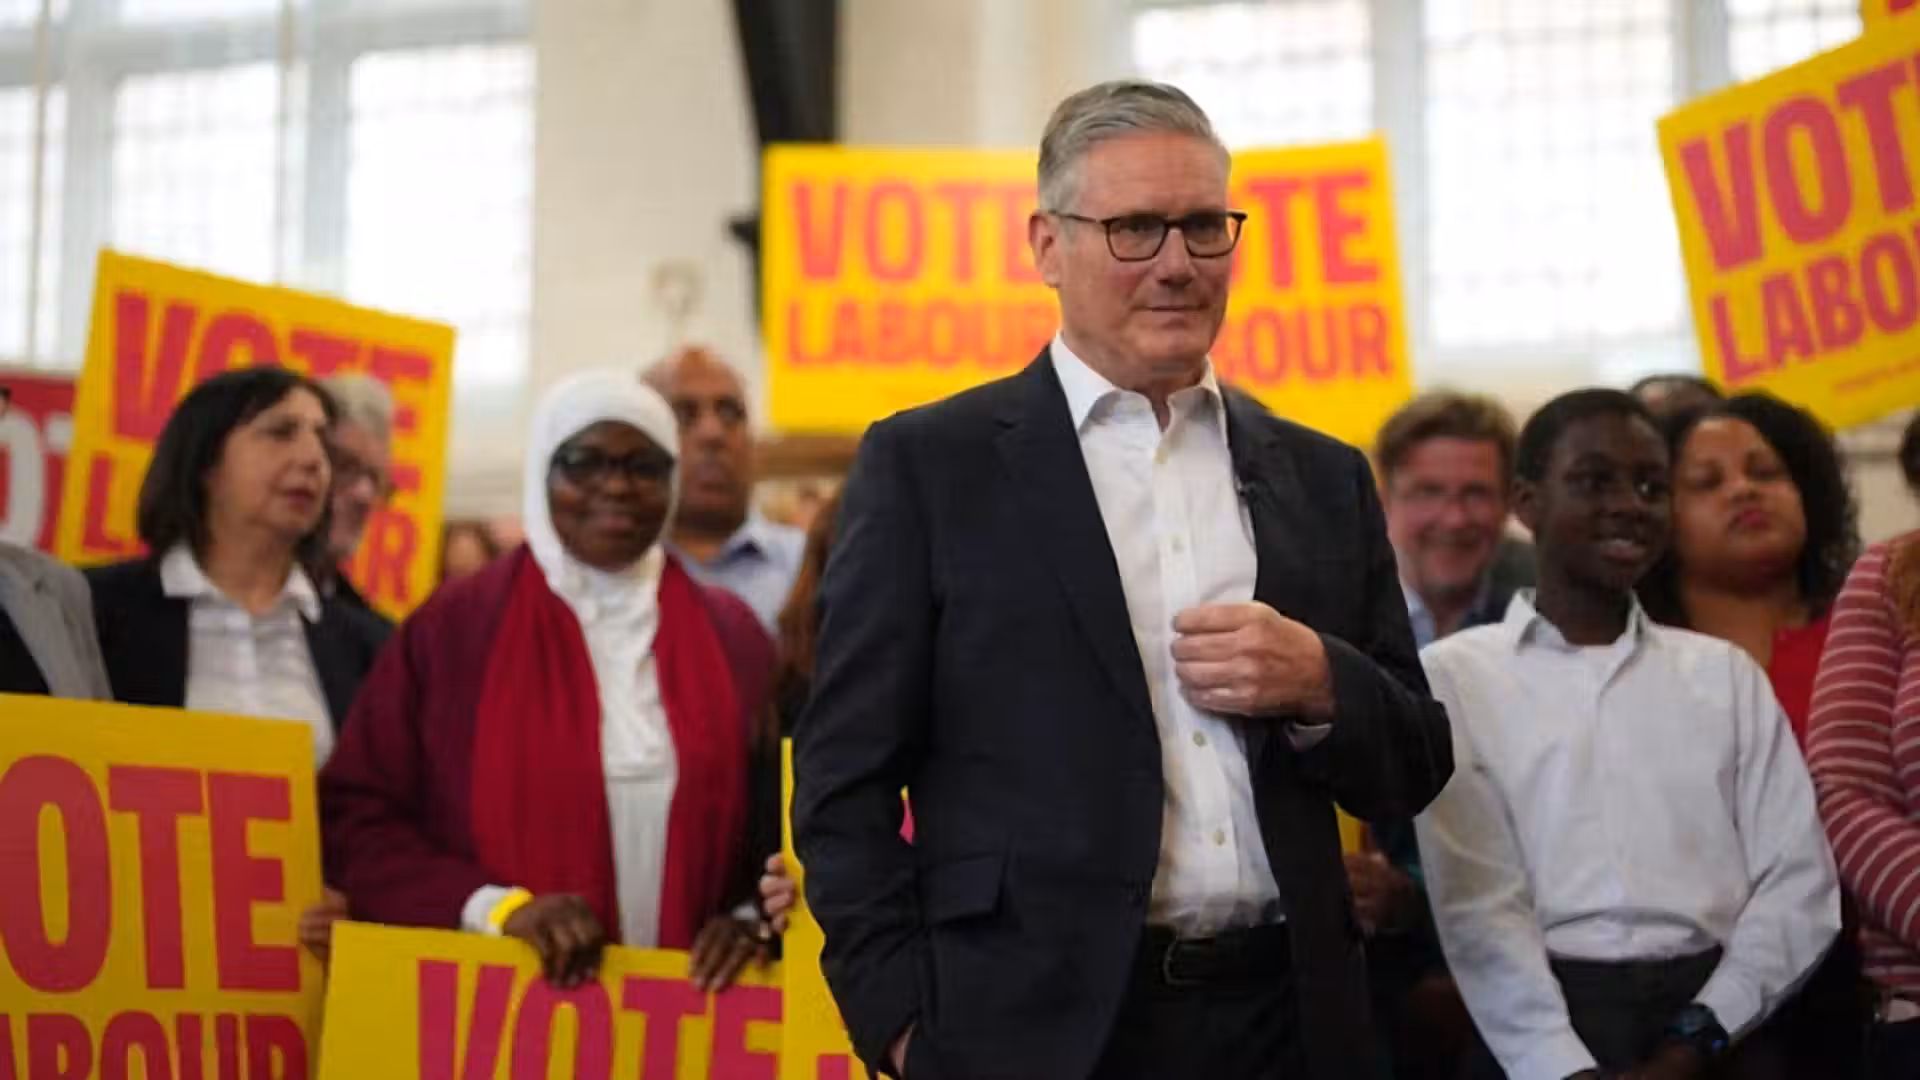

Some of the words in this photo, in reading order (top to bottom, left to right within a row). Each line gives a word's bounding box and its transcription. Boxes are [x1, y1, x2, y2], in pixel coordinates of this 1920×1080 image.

[1231, 171, 1378, 287] TE
[1679, 50, 1920, 269] VOT
[1710, 222, 1920, 384] LABO
